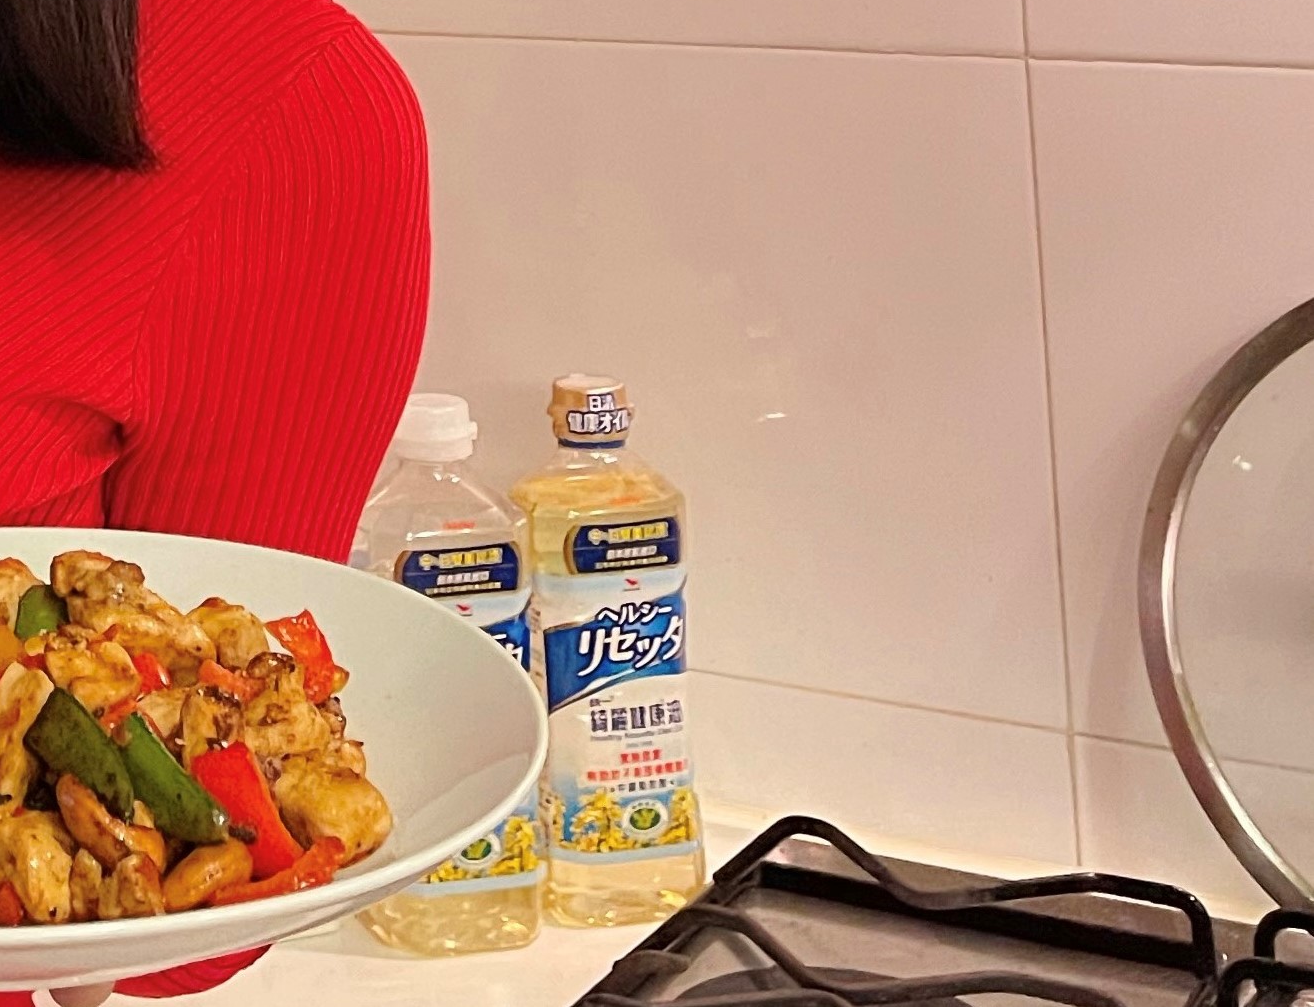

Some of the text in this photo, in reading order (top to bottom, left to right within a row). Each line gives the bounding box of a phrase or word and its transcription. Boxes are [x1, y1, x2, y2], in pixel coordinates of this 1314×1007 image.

[597, 603, 673, 625] ヘルシー
[578, 615, 684, 677] リセッタ
